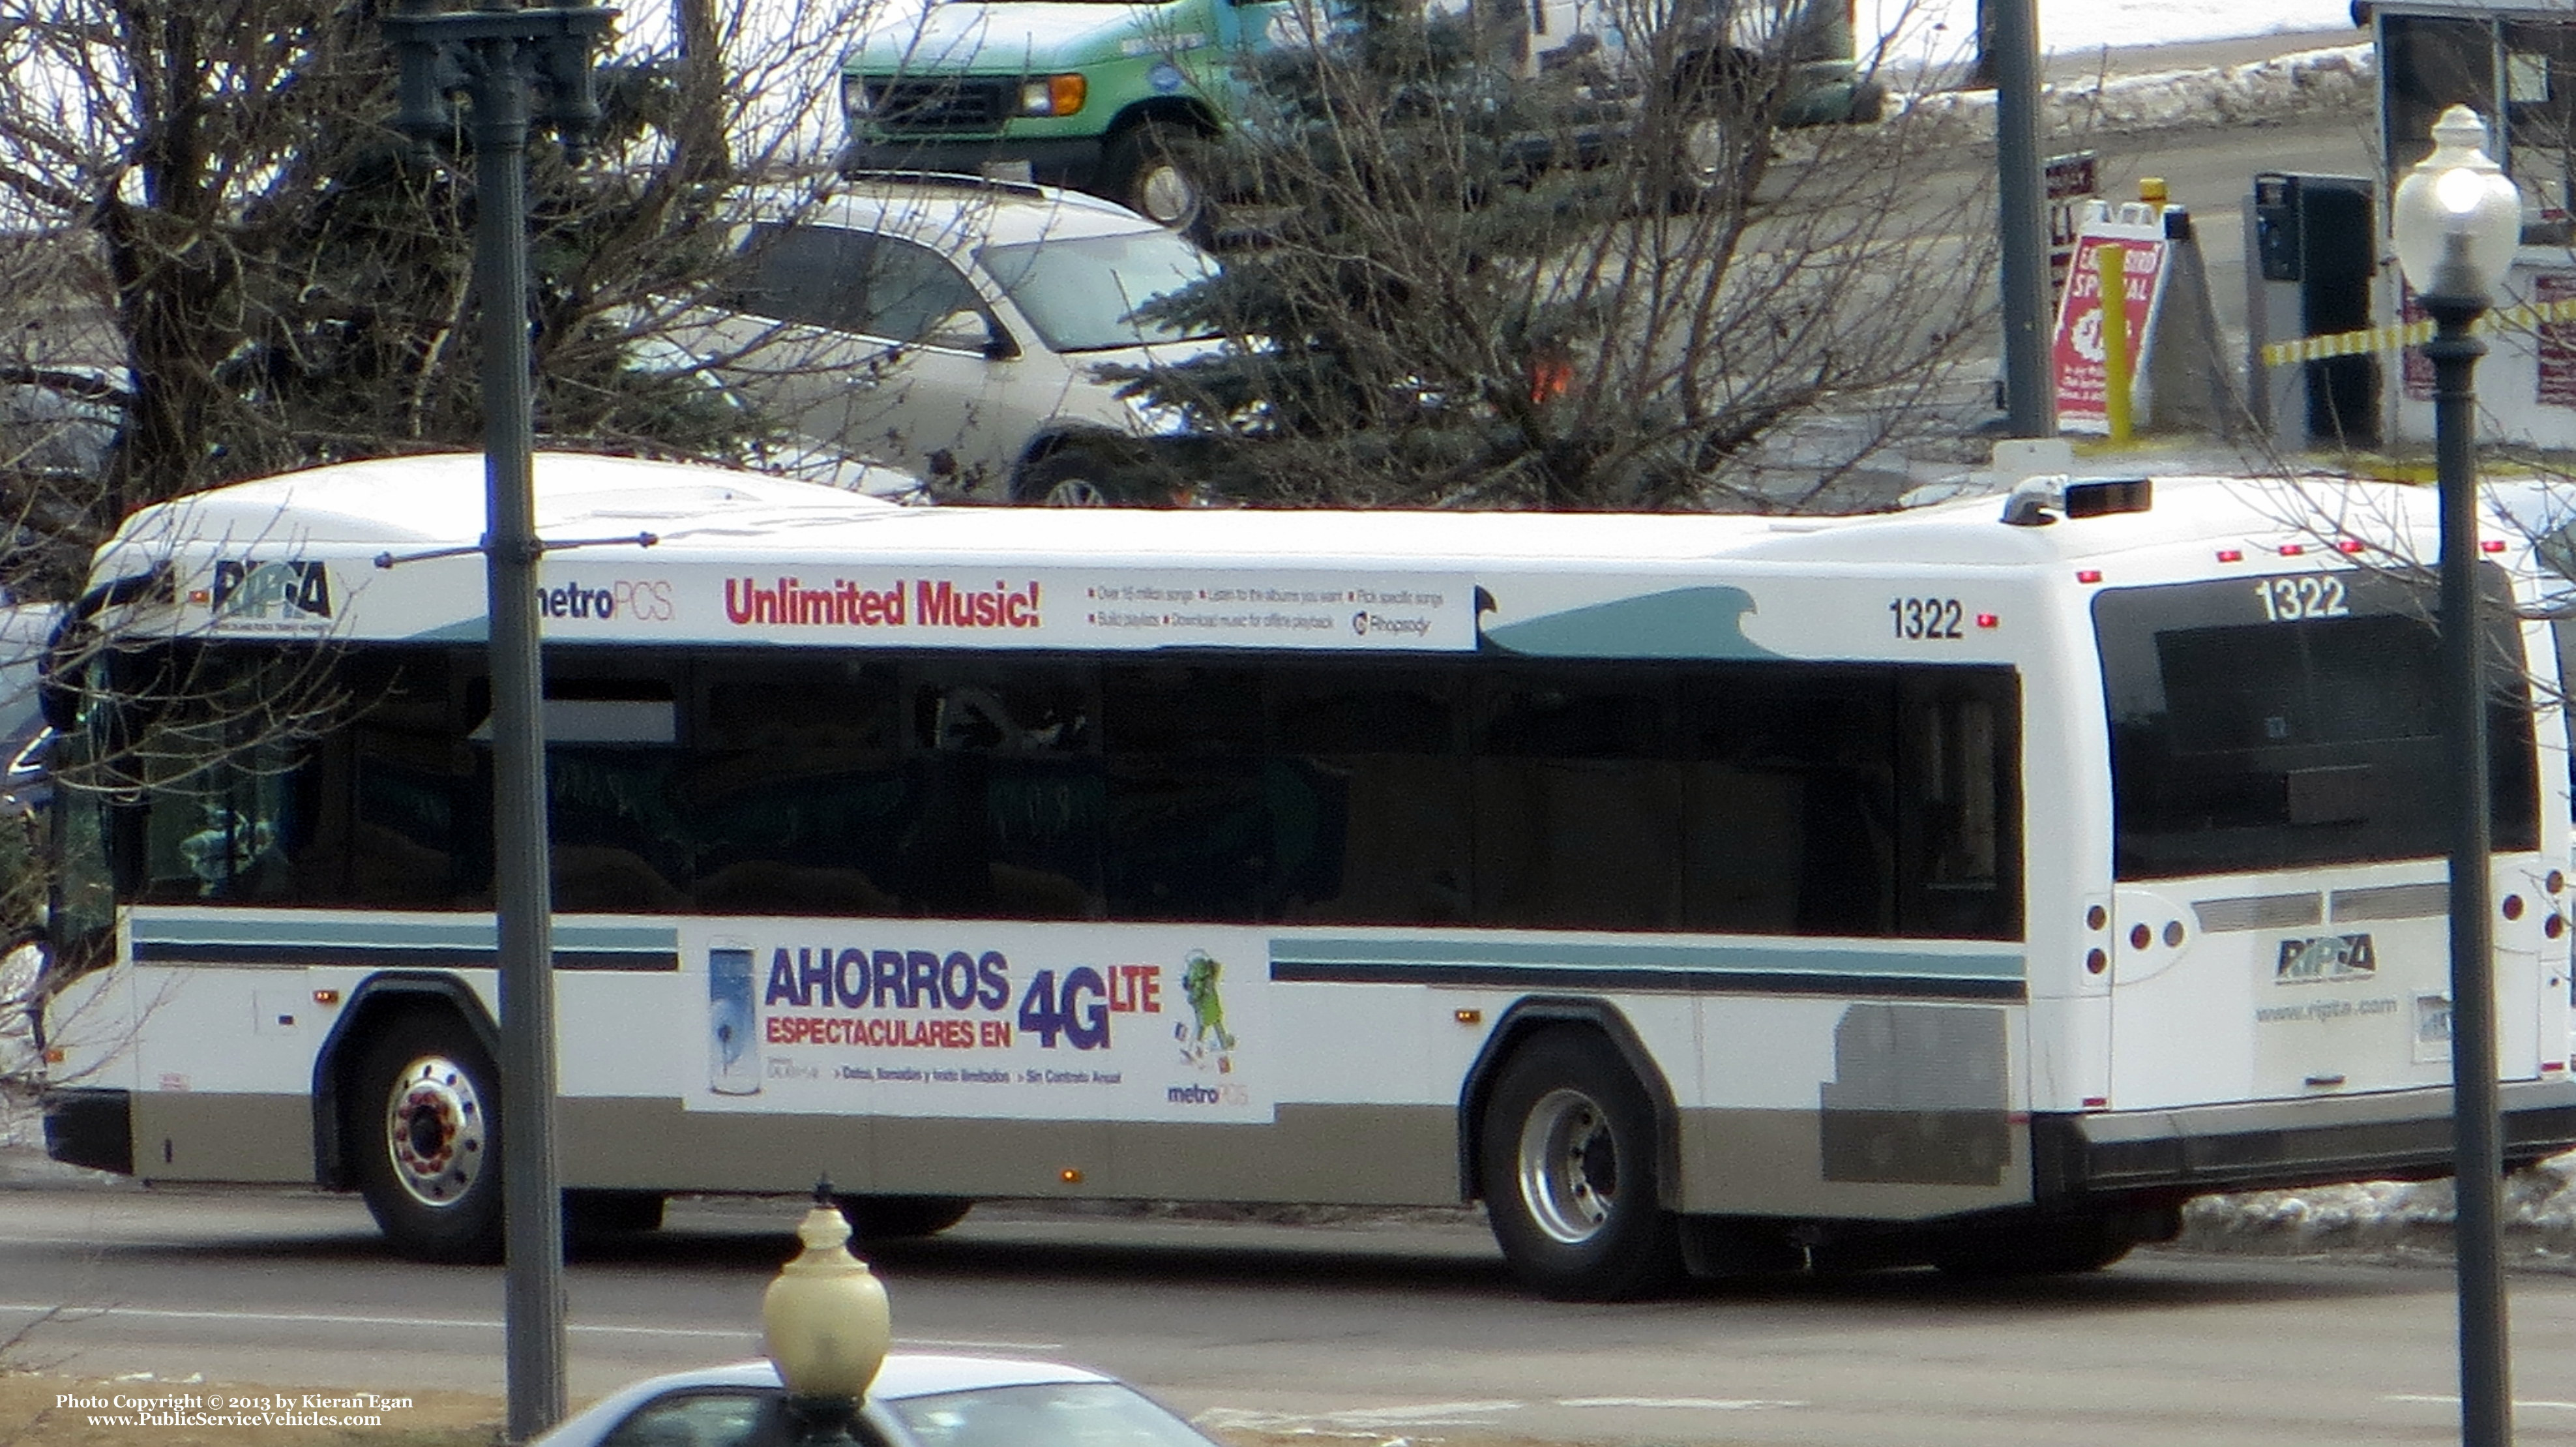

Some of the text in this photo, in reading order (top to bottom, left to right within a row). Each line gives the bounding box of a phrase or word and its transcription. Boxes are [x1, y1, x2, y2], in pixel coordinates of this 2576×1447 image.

[2072, 273, 2147, 301] SPAL
[726, 577, 1039, 627] Unlimited Music!
[2255, 575, 2350, 621] 1322
[1370, 615, 1431, 636] Rhapsody
[1889, 597, 1963, 638] 1322
[764, 947, 1011, 1011] AHORROS
[2256, 998, 2399, 1022] www.ripta.com
[766, 1018, 1011, 1049] ESPECTACULARES EN
[1026, 1067, 1043, 1083] Sin
